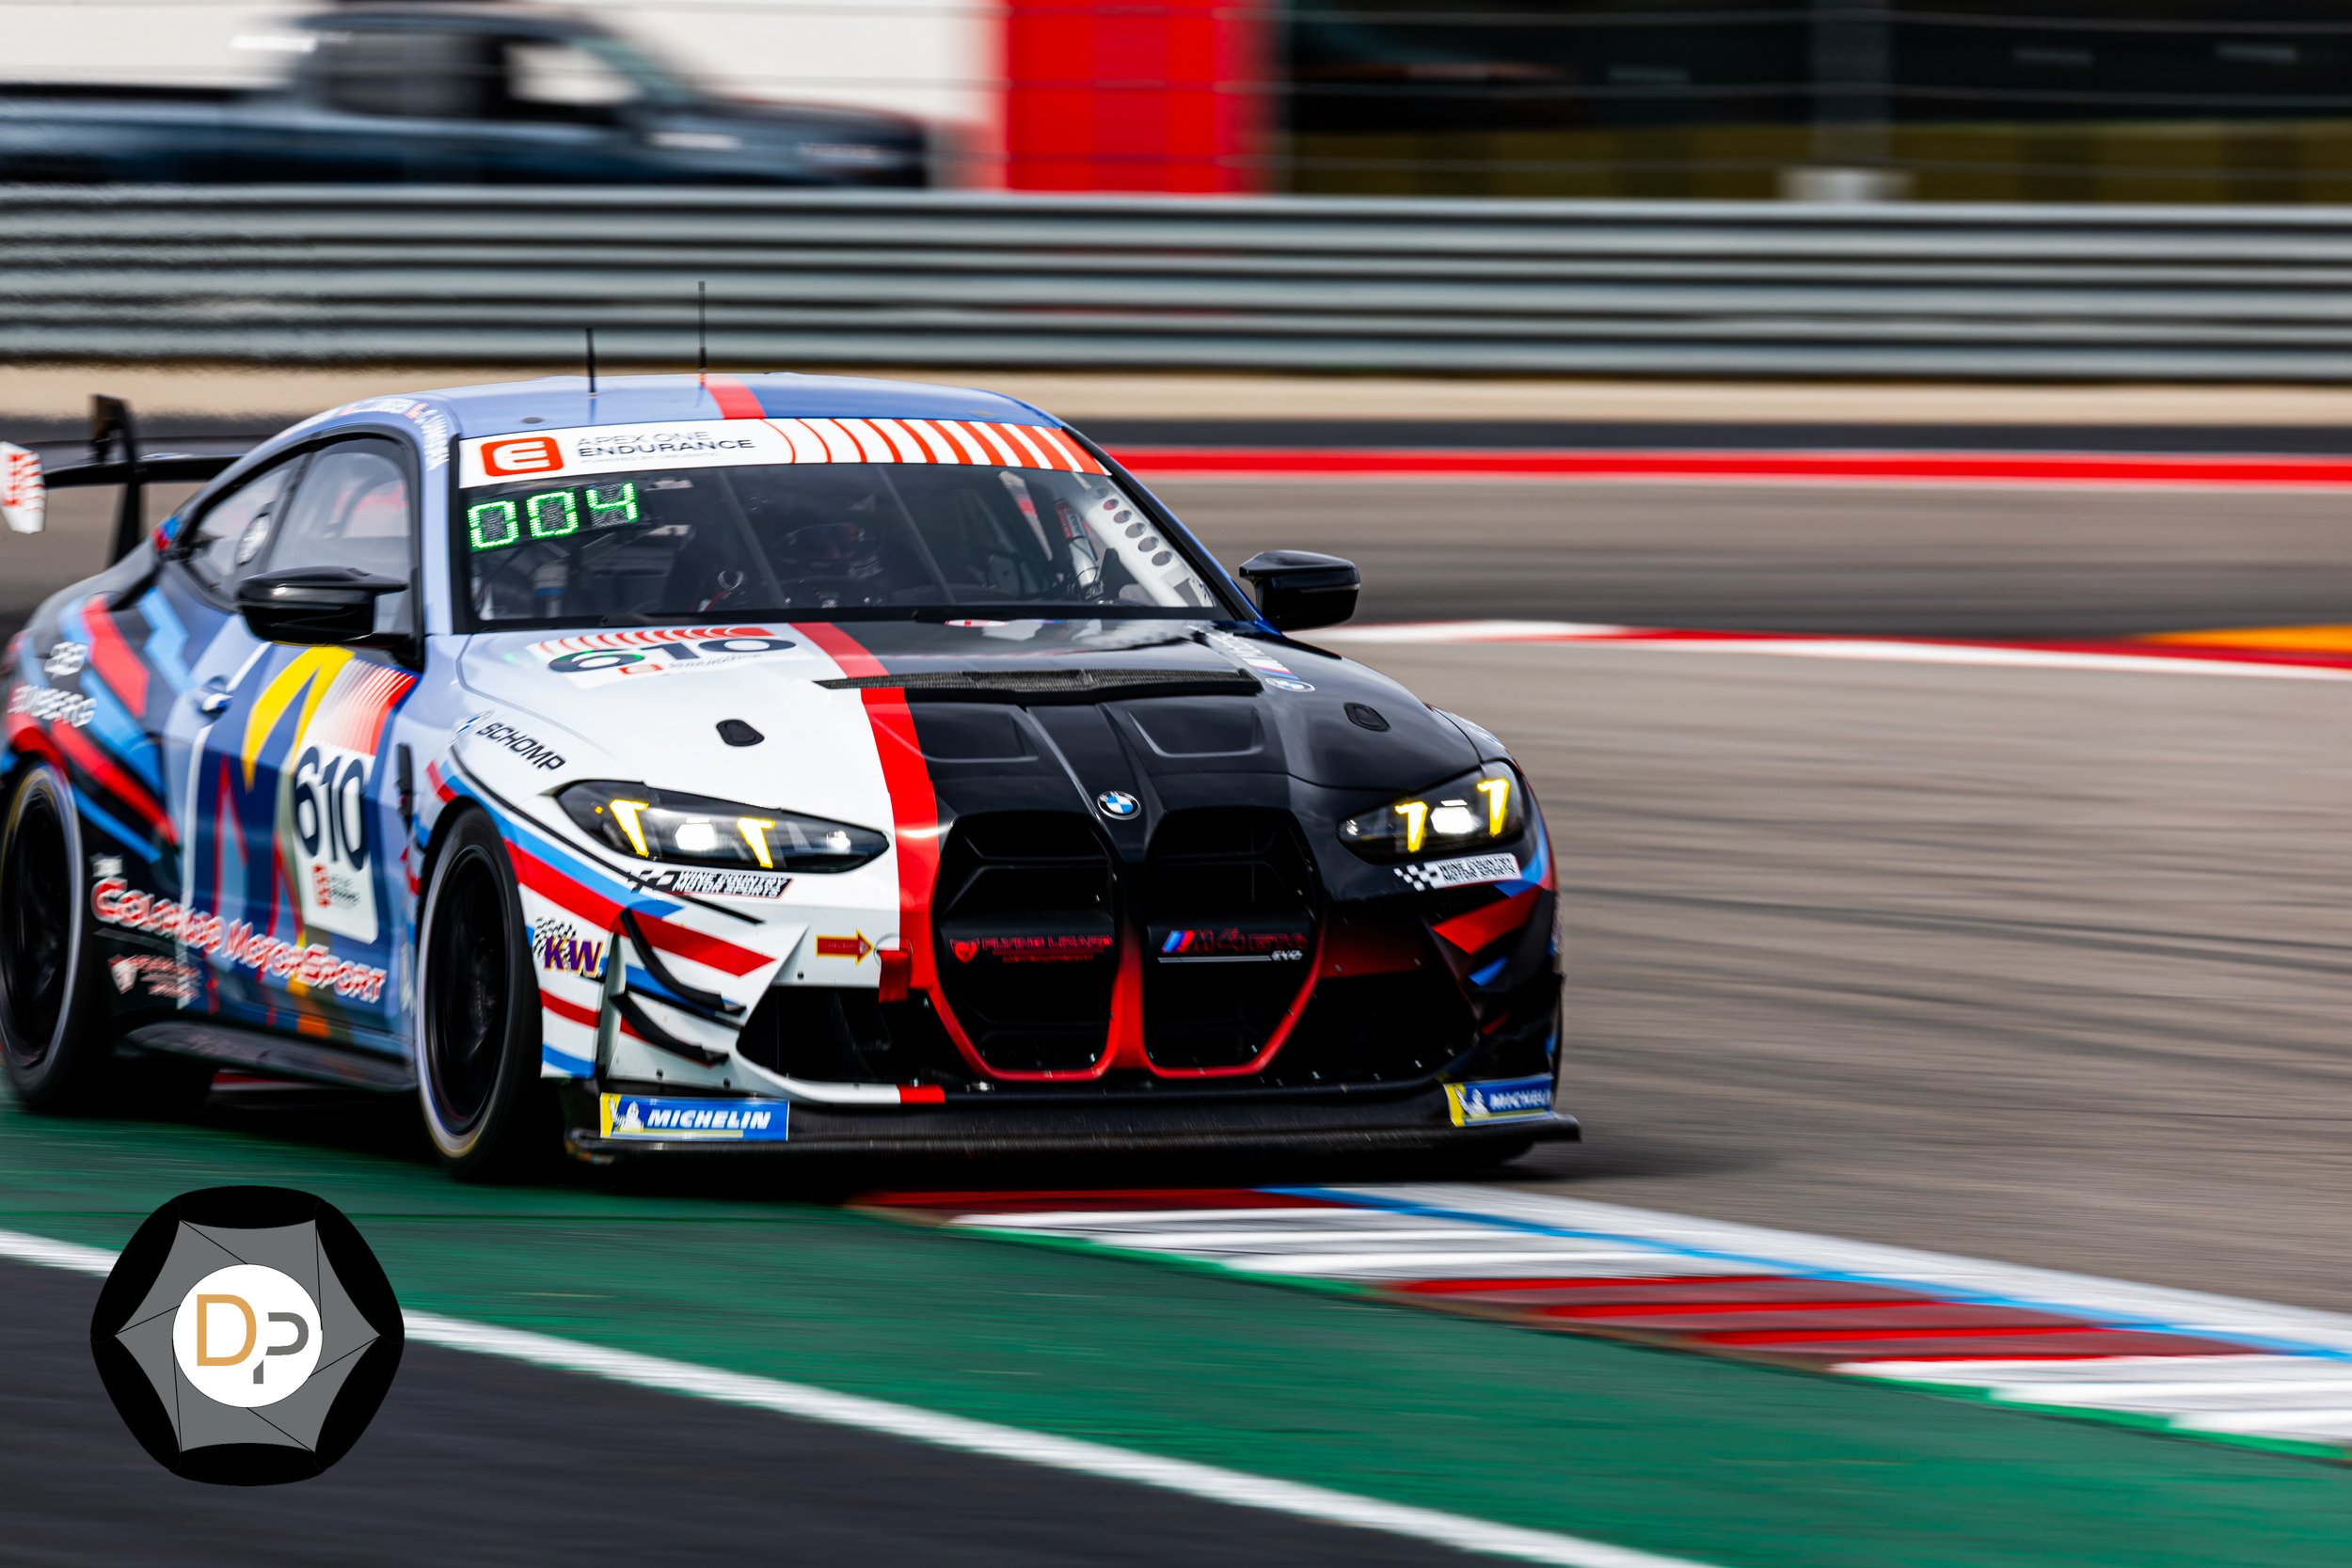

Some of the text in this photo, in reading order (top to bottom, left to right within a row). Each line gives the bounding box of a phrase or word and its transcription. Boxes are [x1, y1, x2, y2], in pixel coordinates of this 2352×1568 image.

[577, 431, 711, 447] APEX ONE
[579, 439, 755, 457] ENDURANCE
[468, 482, 638, 550] 004
[548, 638, 797, 673] 610
[475, 721, 566, 770] SCHOMP
[294, 745, 370, 871] 610
[672, 880, 723, 893] MOTOR
[677, 871, 787, 887] WINE COUNTRY
[544, 936, 603, 977] KW
[647, 1109, 771, 1130] MICHELIN
